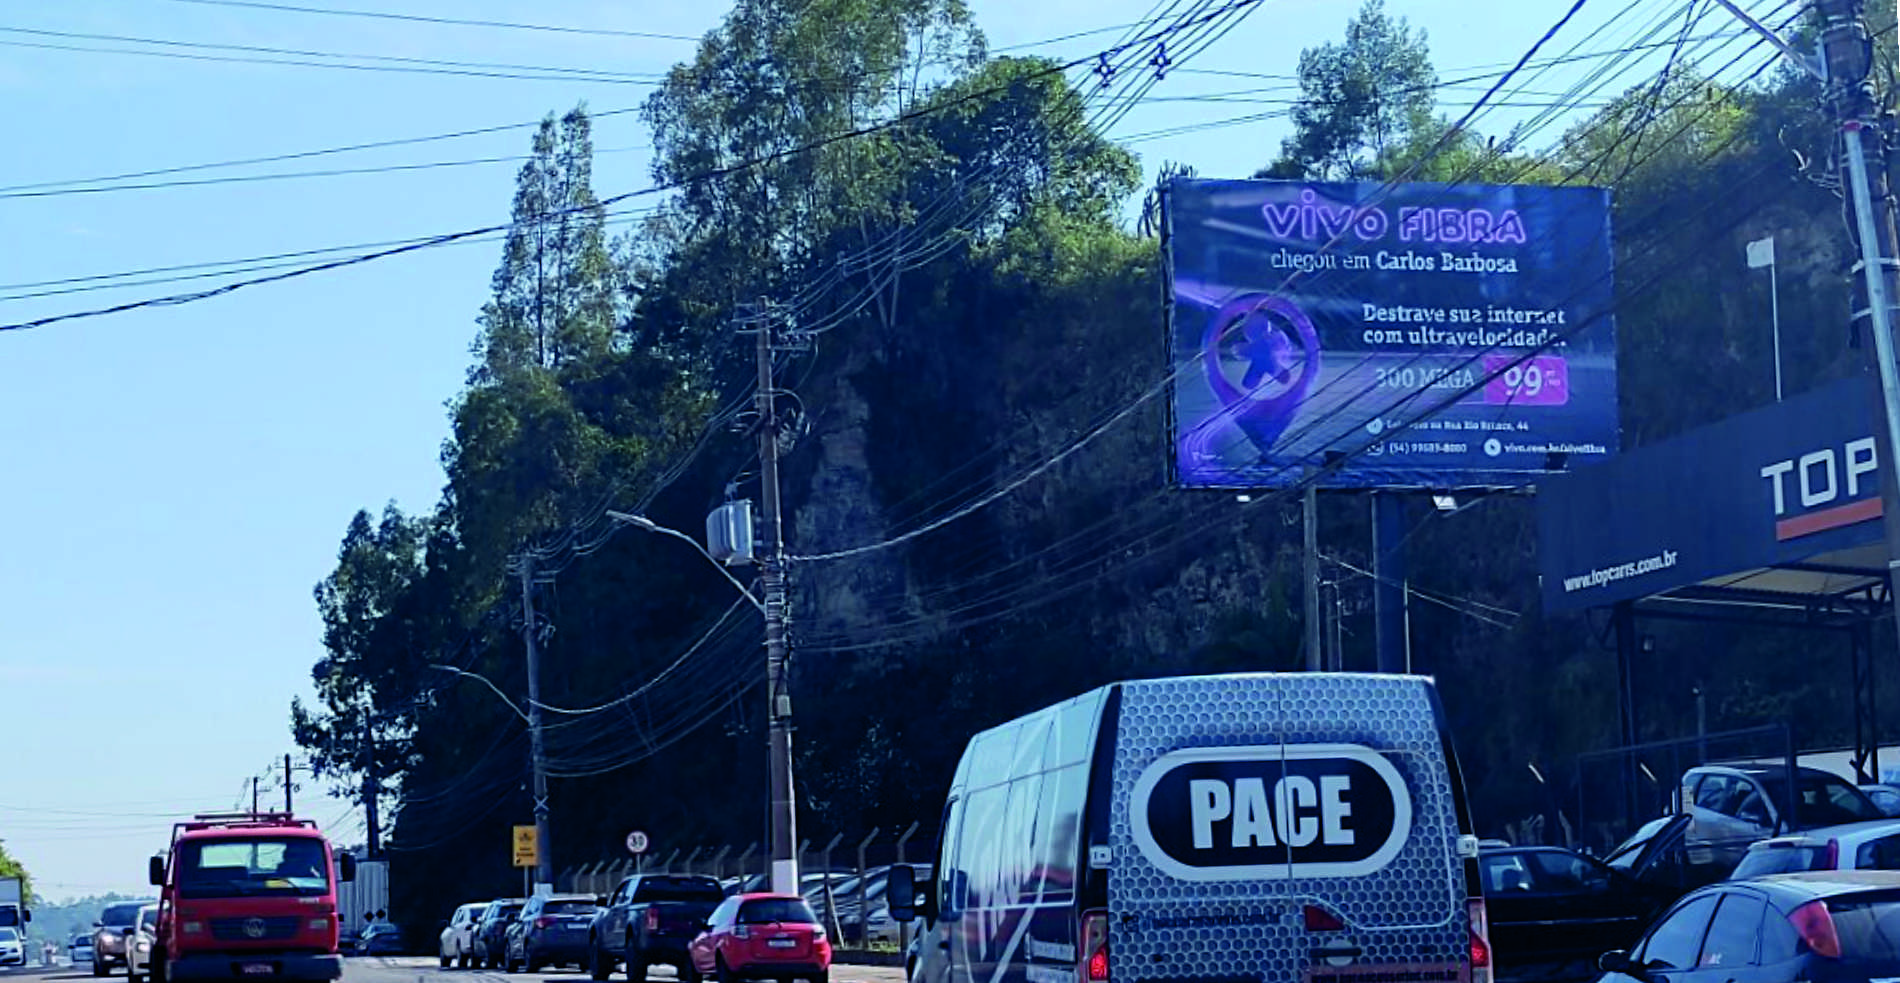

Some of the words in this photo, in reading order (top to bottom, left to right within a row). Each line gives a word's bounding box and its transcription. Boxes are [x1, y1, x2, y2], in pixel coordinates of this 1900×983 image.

[1399, 206, 1526, 243] FIBRA
[1270, 248, 1336, 272] chegou
[1344, 252, 1370, 270] em
[1376, 250, 1435, 271] Carlos
[1441, 251, 1519, 273] Barbosa
[1362, 303, 1445, 322] Destrave
[1363, 328, 1404, 345] com
[1376, 367, 1415, 388] 300
[1419, 367, 1475, 388] MEGA
[1504, 365, 1542, 397] 99
[1761, 437, 1878, 515] TOP
[1190, 775, 1354, 849] PACE
